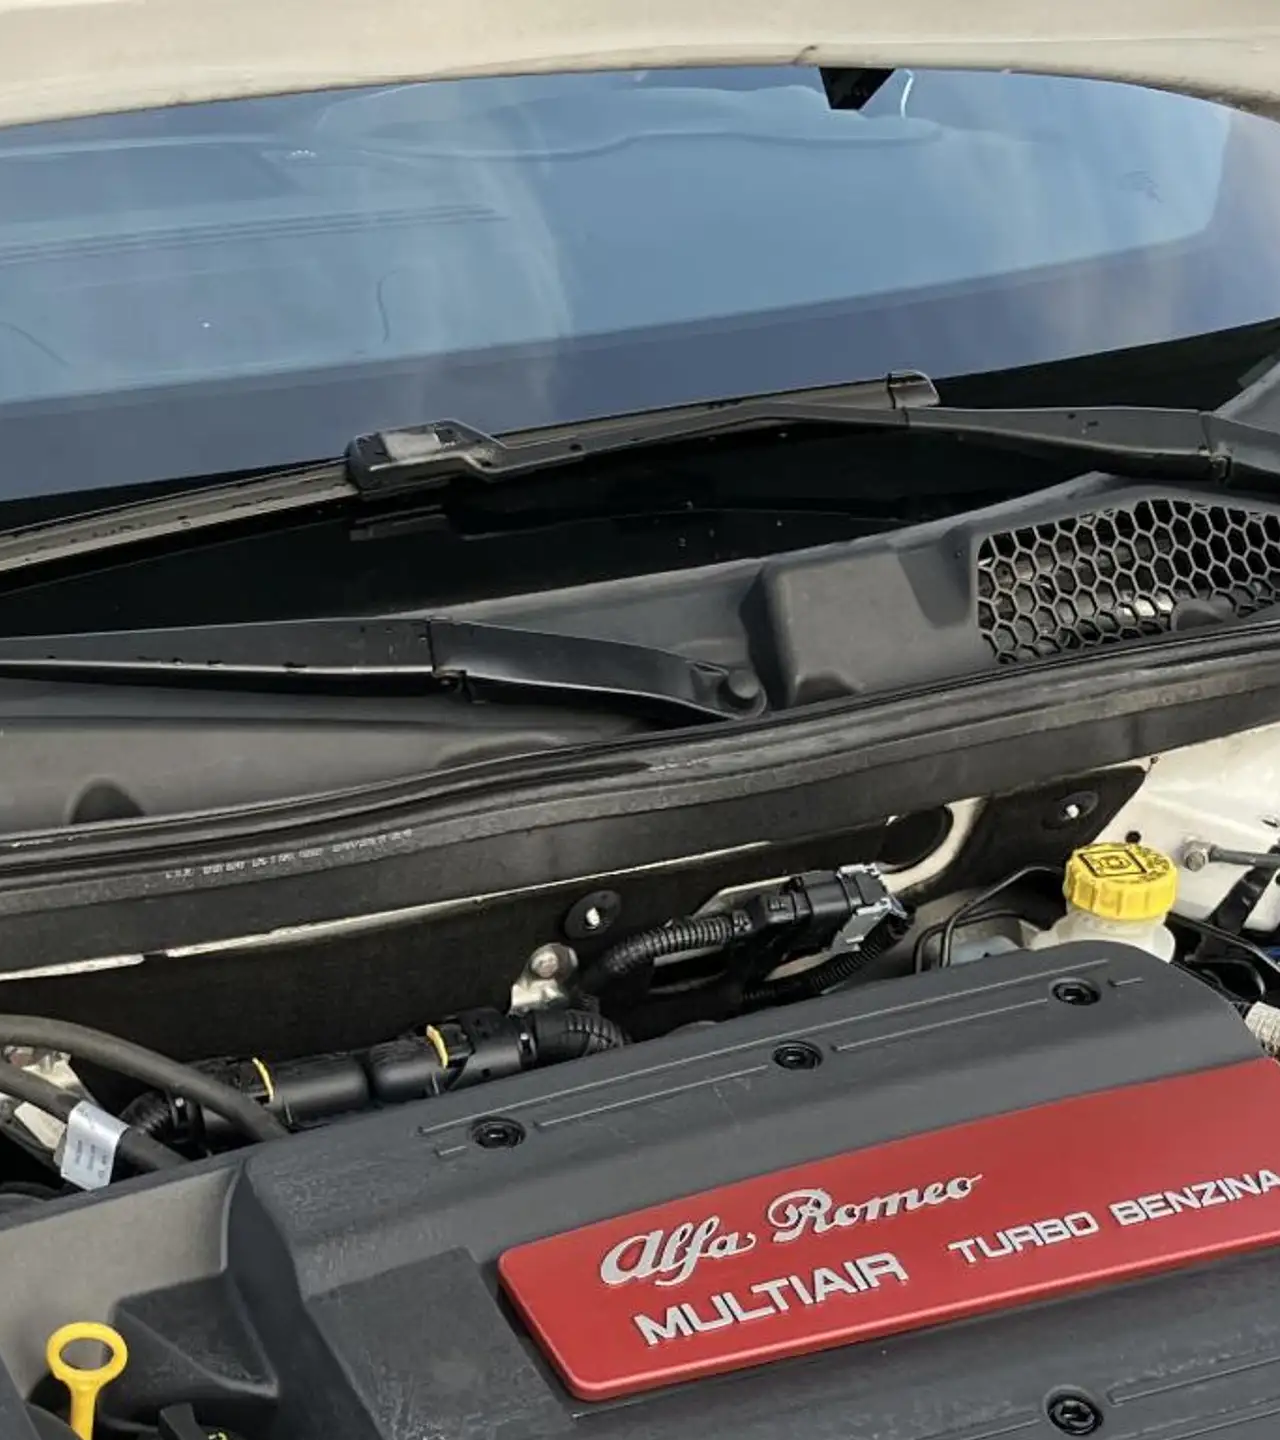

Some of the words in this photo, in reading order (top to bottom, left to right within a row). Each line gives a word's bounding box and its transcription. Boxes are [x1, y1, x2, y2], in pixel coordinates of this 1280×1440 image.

[599, 1226, 755, 1288] Alfa
[767, 1174, 983, 1241] Romeo
[948, 1212, 1100, 1267] TURBO
[632, 1252, 909, 1346] MULTIAIR
